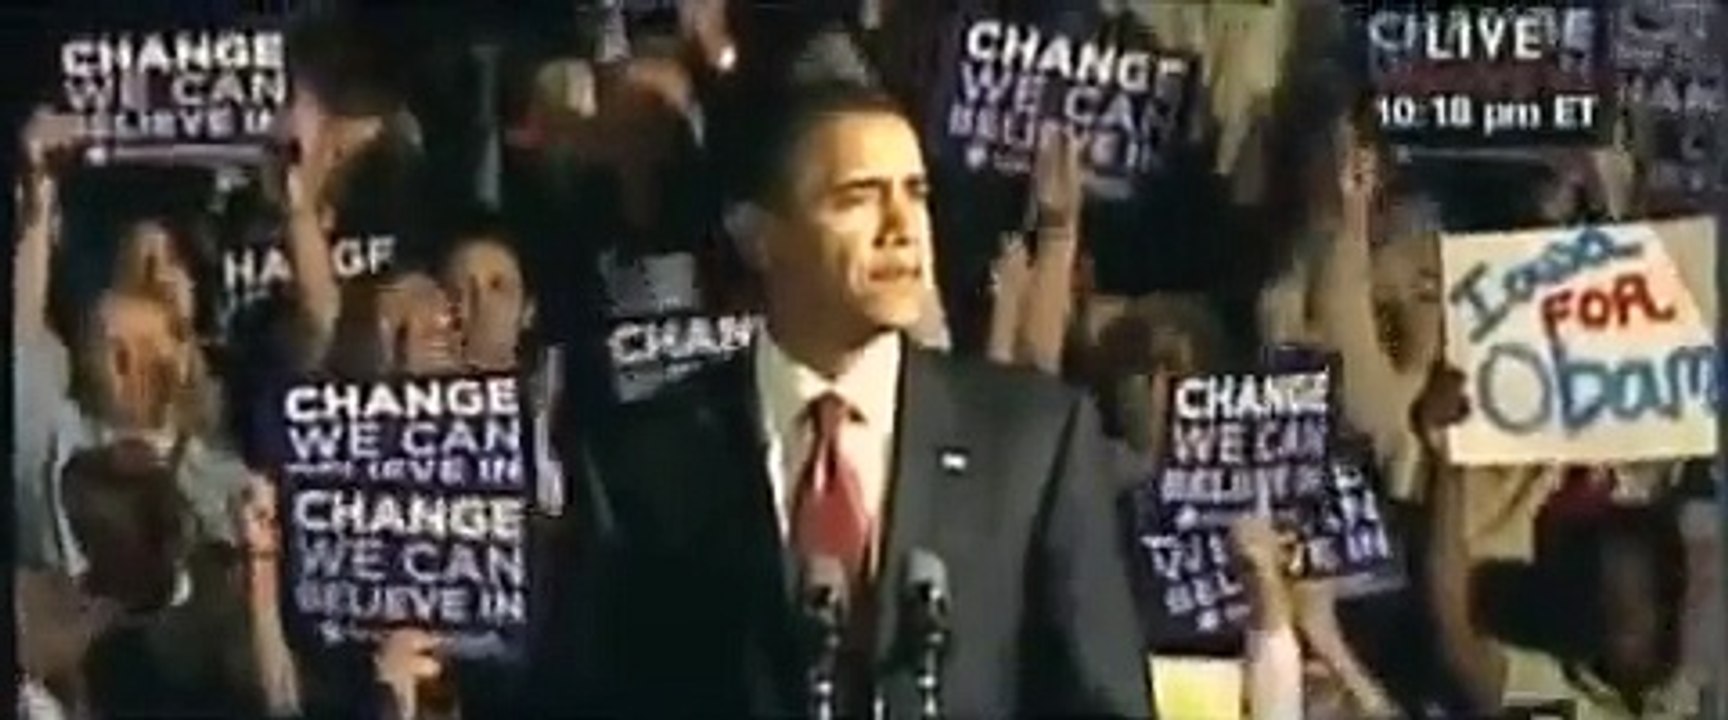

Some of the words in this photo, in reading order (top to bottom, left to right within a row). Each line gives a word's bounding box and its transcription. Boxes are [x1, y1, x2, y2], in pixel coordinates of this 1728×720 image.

[62, 32, 284, 75] CHANGE
[966, 20, 1188, 94] CHANGE
[172, 73, 287, 105] CAN
[1541, 272, 1677, 332] FOR
[285, 378, 519, 421] CHANGE
[288, 423, 381, 459] WE
[401, 419, 521, 456] CAN
[1172, 421, 1244, 462] WE
[293, 488, 525, 541] CHANGE
[302, 536, 386, 581] WE
[403, 542, 525, 586] CAN
[295, 578, 469, 622] BELIEVE
[480, 588, 525, 625] IN
